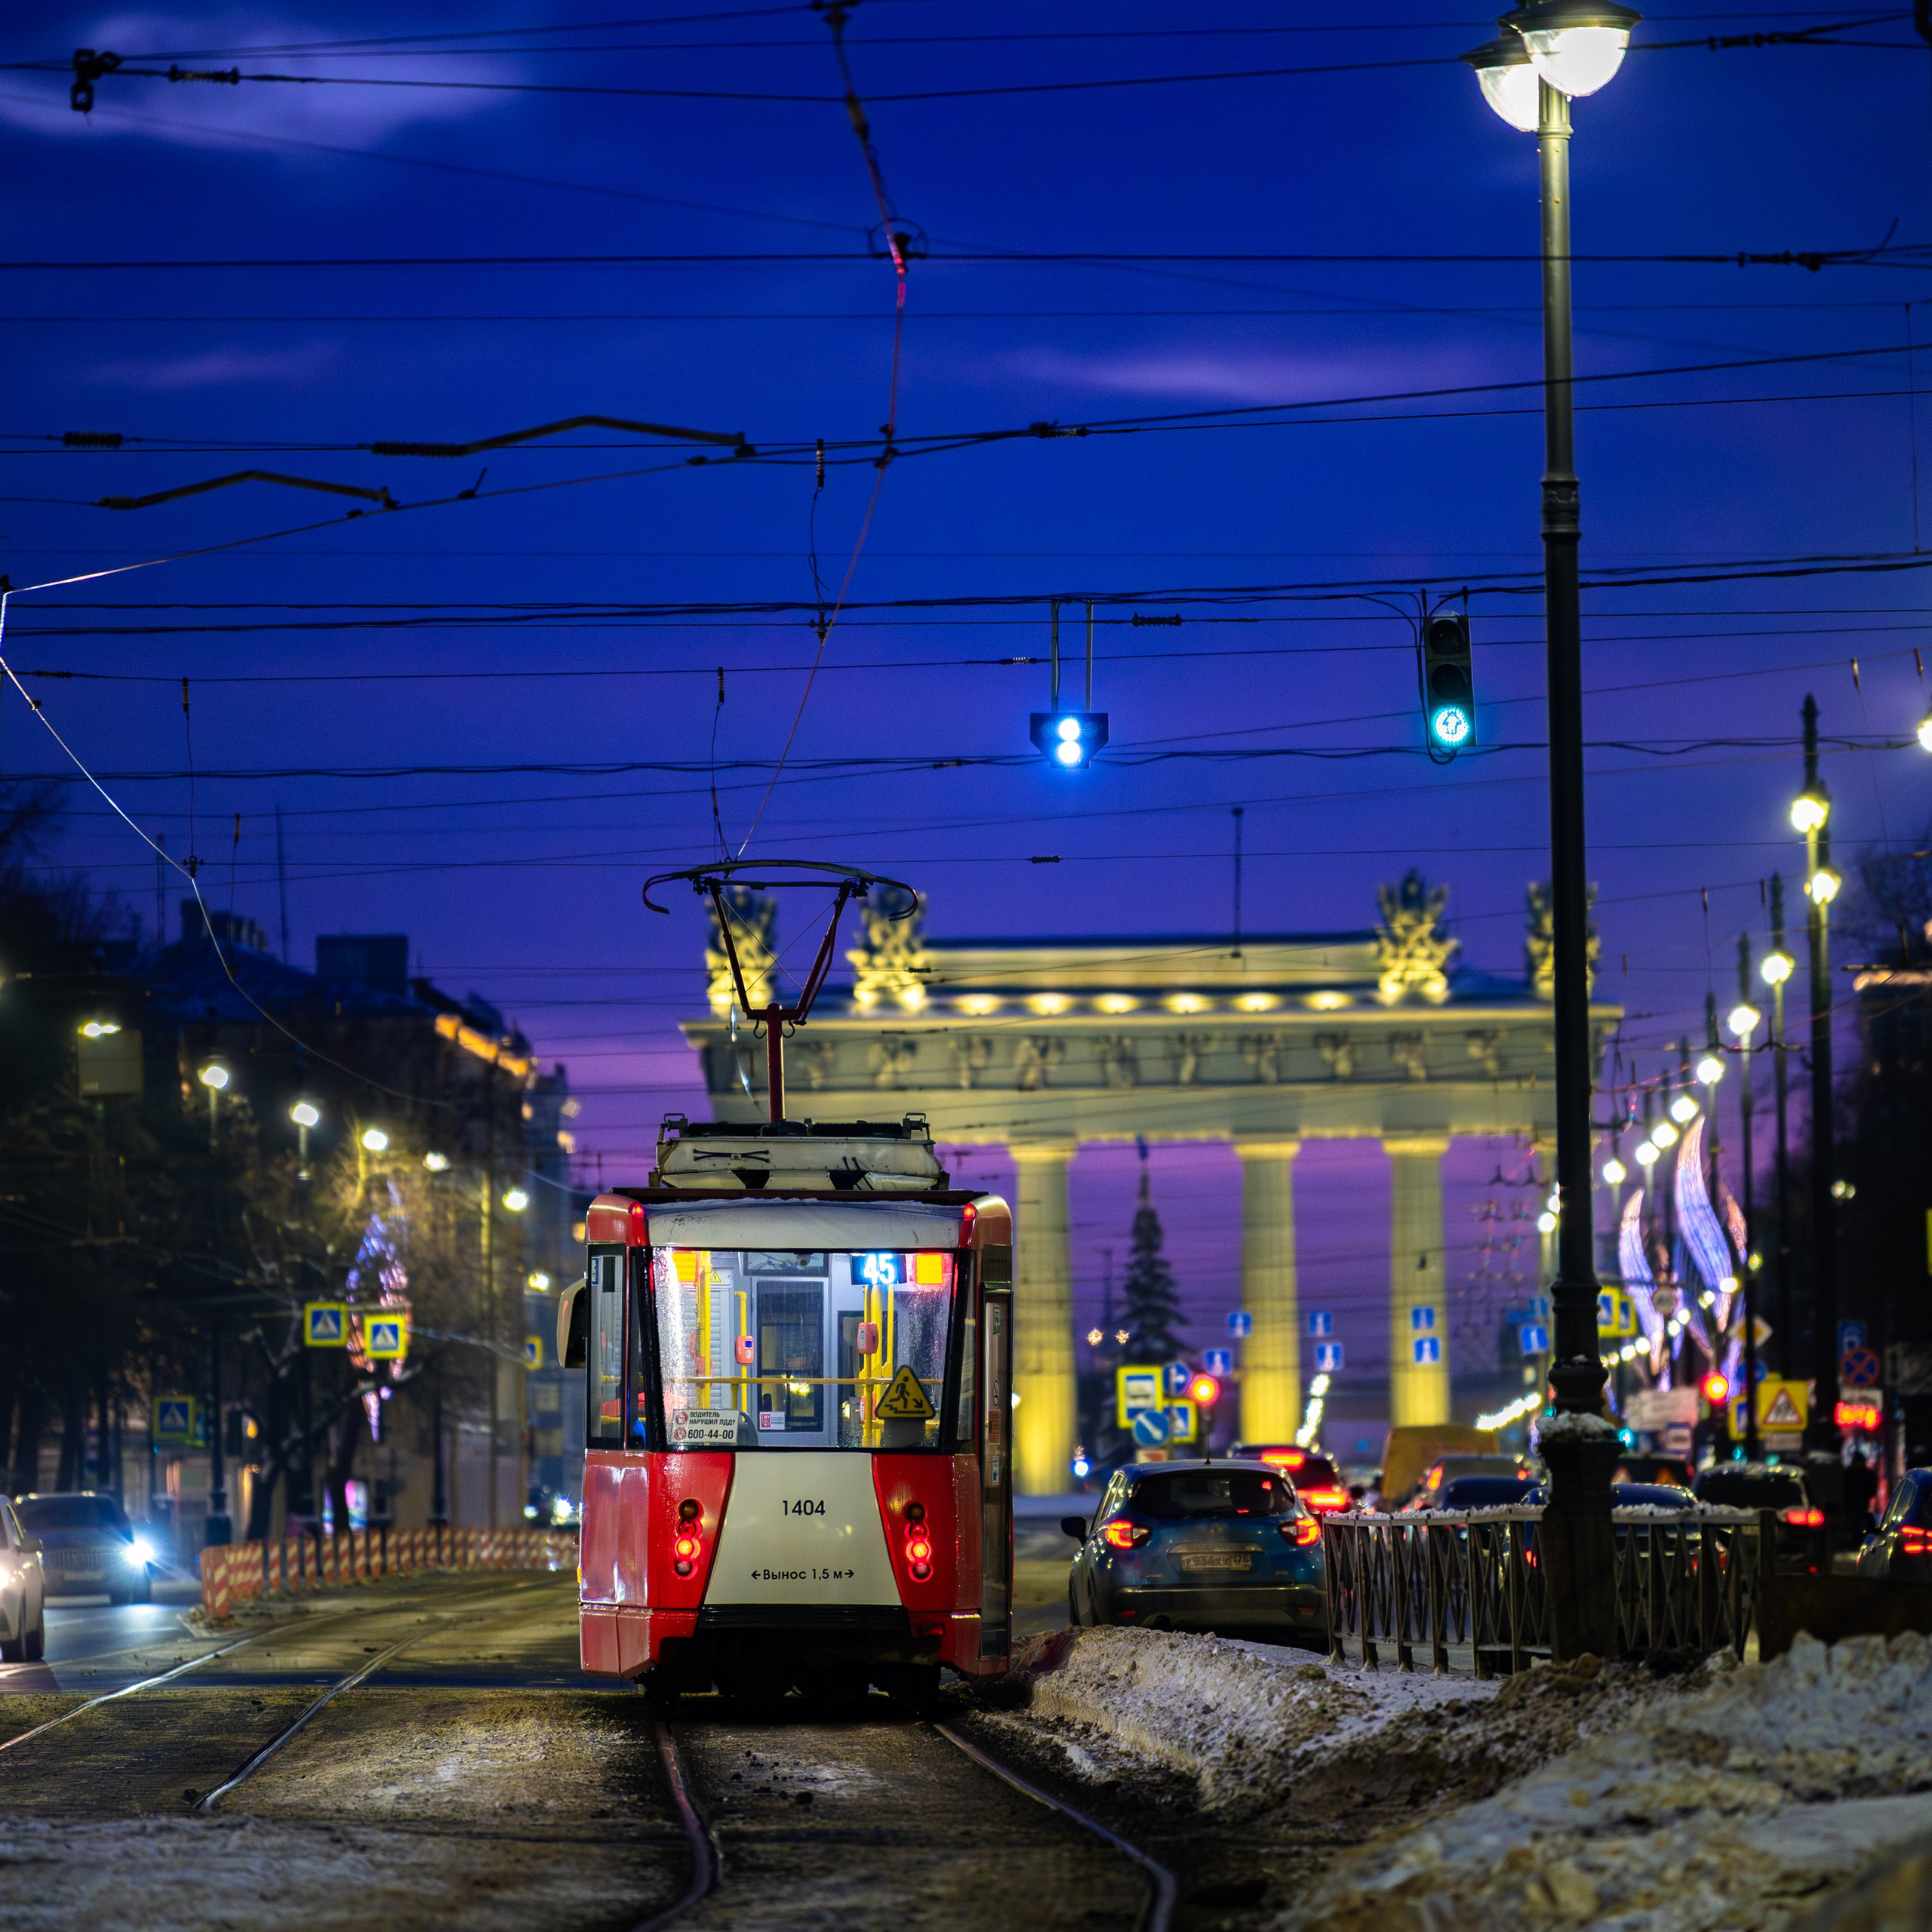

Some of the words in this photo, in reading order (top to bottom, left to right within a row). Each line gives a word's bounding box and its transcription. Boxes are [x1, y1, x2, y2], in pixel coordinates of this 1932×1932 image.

[863, 1254, 895, 1284] 45
[688, 1429, 734, 1439] 600-44-00
[783, 1500, 826, 1515] 1404
[763, 1569, 807, 1580] Вынос
[812, 1568, 829, 1581] 1,5
[833, 1571, 842, 1579] м
